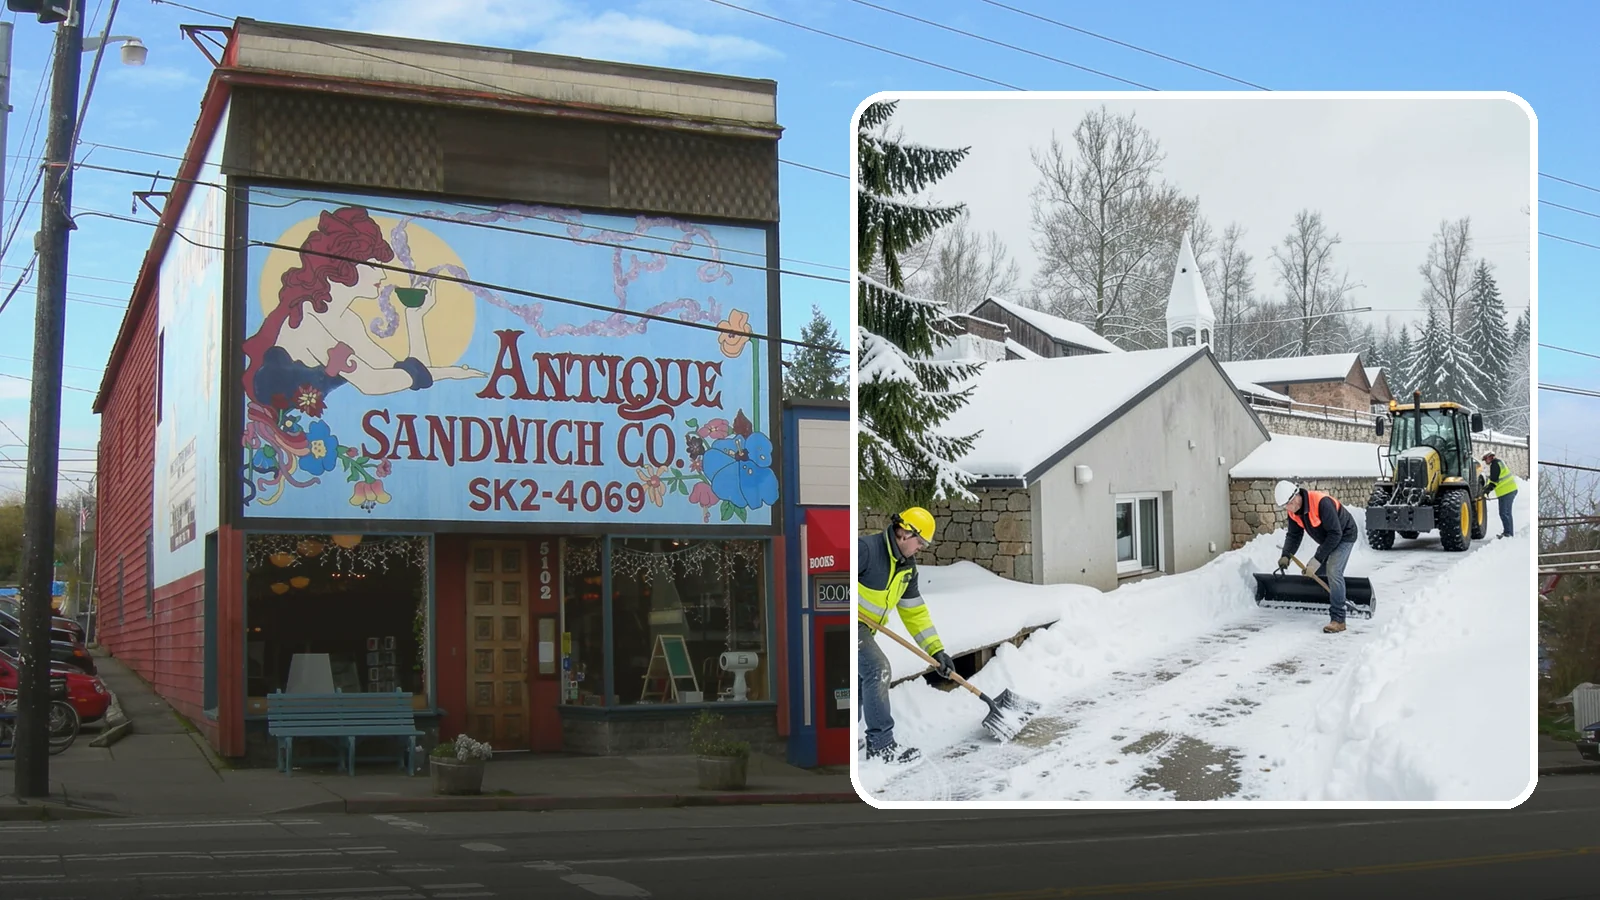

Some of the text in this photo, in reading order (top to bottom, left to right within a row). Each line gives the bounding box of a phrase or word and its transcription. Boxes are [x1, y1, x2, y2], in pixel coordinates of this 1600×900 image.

[475, 328, 724, 421] ANTIQUE
[361, 407, 684, 468] SANDWICH CO.
[468, 477, 646, 513] SK2-4069
[540, 541, 551, 600] 5102
[809, 555, 835, 569] BOOKS
